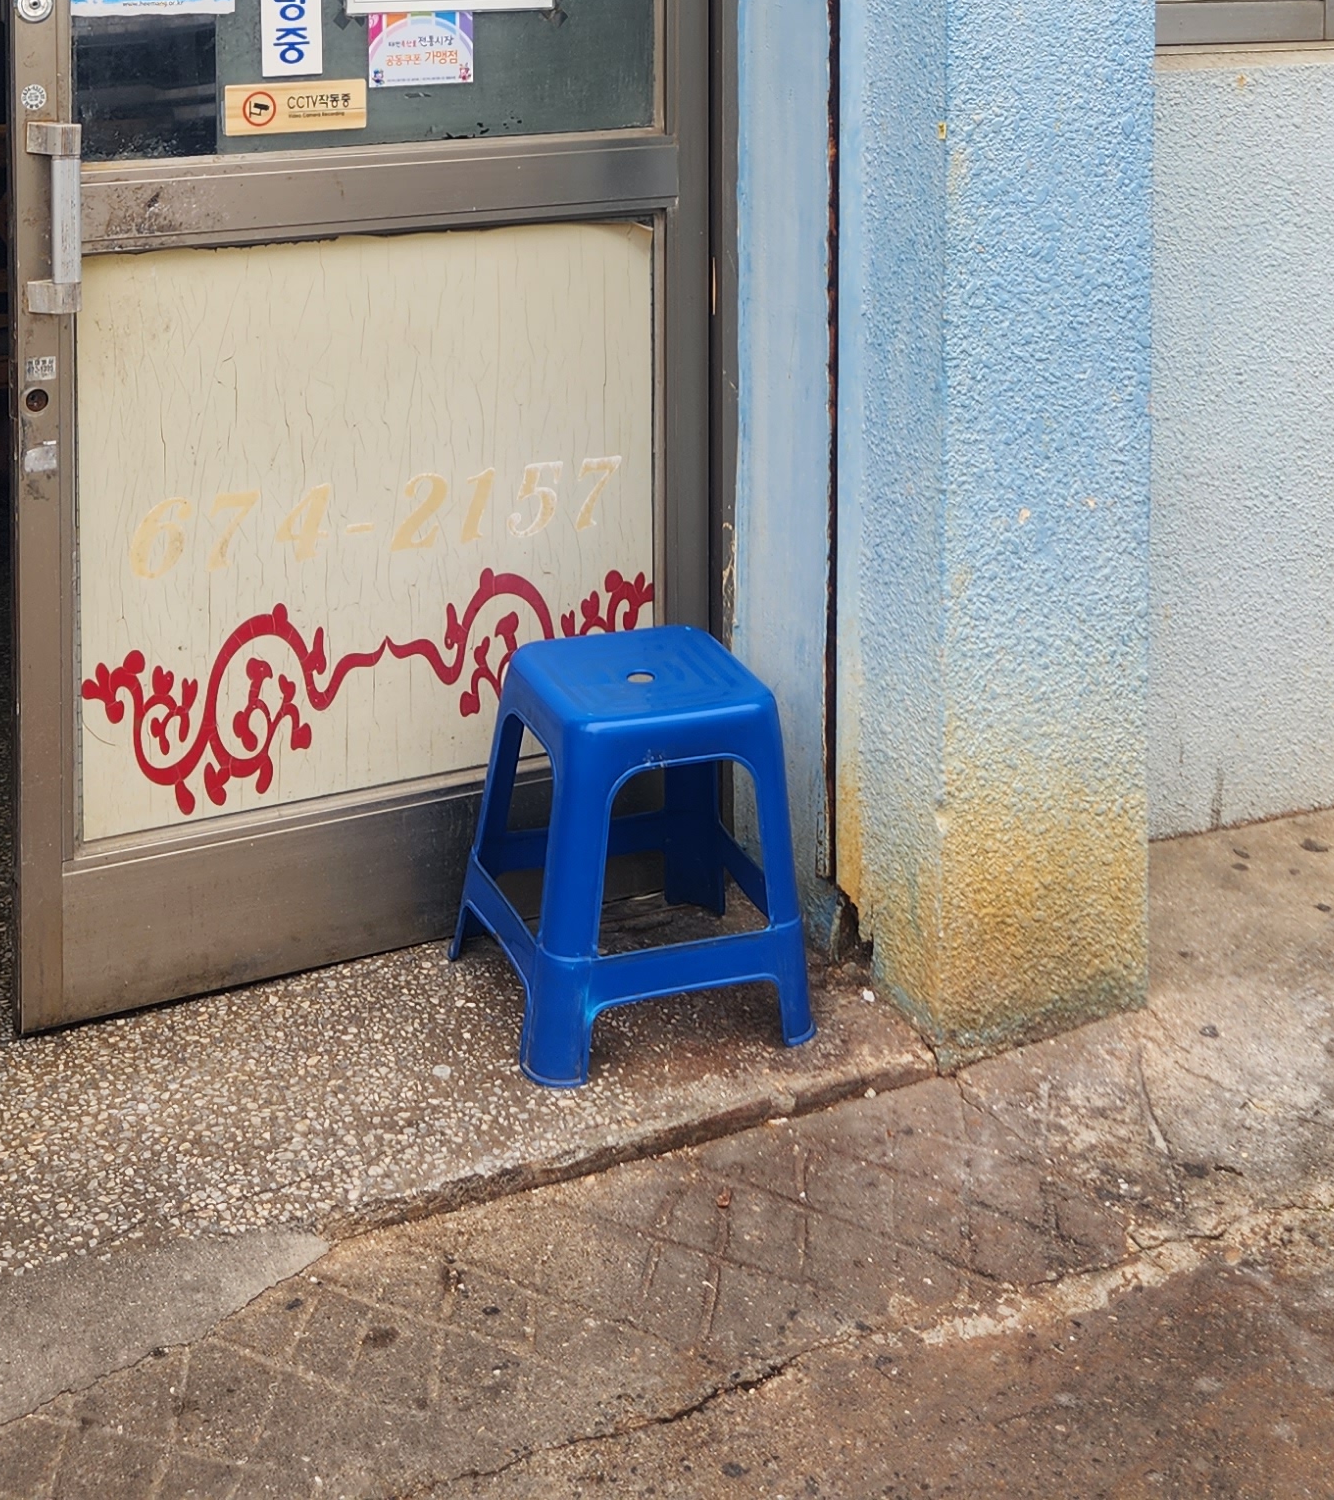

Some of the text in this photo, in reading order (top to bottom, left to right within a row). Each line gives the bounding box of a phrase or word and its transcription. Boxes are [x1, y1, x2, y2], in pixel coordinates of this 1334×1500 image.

[424, 49, 458, 65] 가맹점
[287, 93, 351, 109] CCTV작동중
[129, 454, 622, 580] 674-2157
